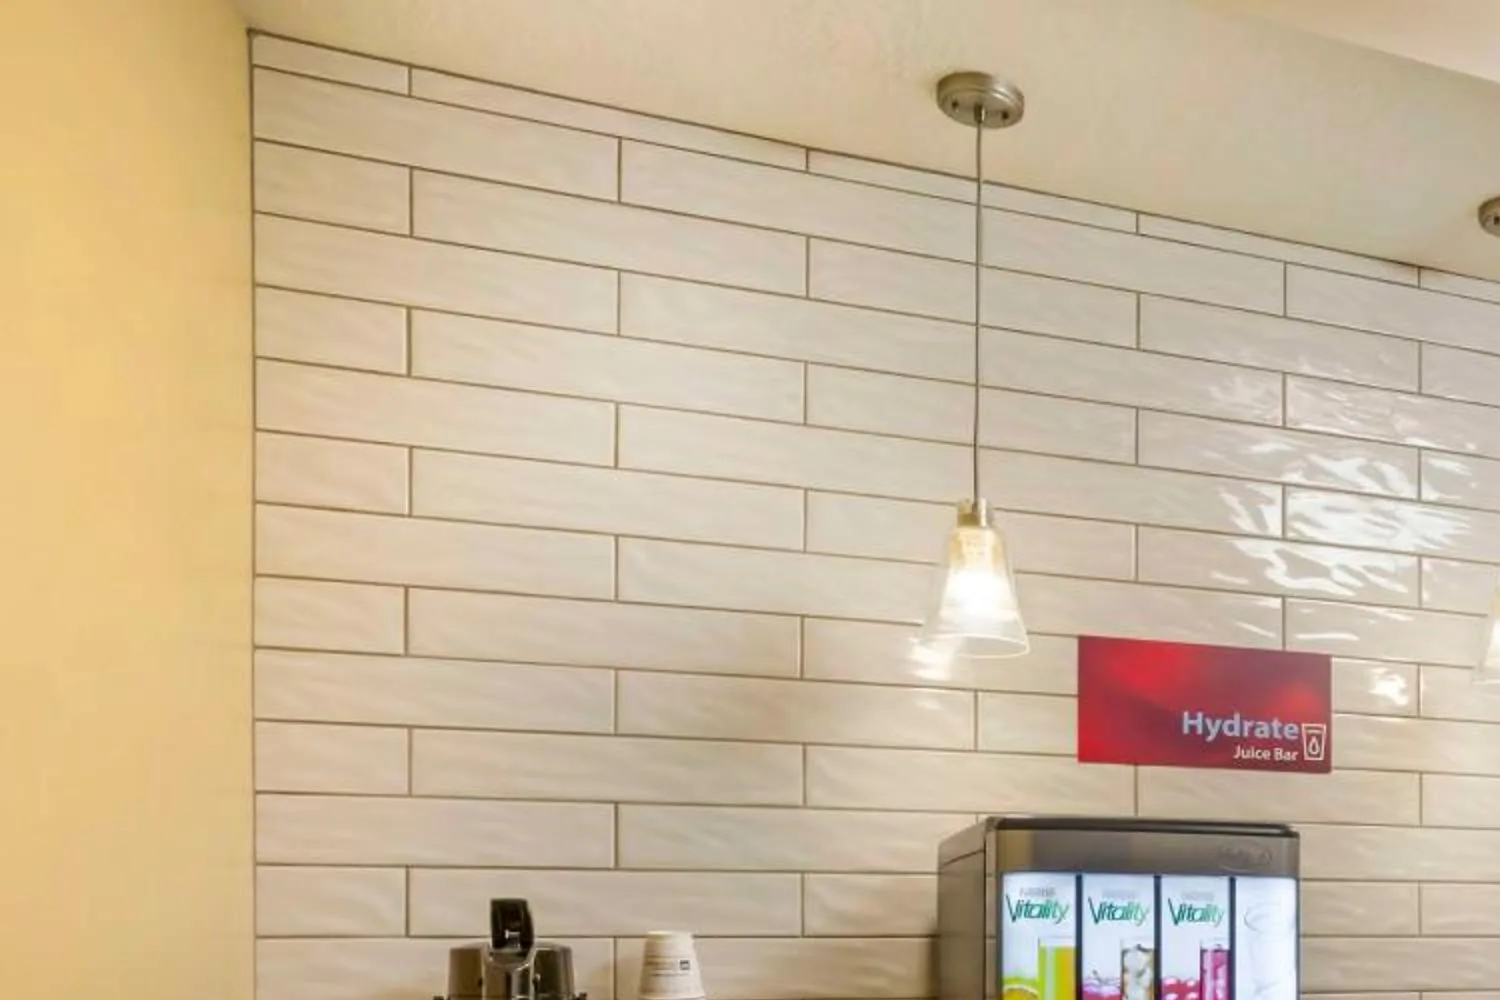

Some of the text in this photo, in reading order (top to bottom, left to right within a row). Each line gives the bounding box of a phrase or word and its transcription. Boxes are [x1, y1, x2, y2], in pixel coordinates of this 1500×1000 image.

[1182, 711, 1300, 742] Hydrate
[1233, 744, 1299, 761] Juice Bar
[1005, 893, 1070, 925] Vitality
[1087, 896, 1149, 927] Vitality
[1167, 897, 1225, 928] Vitality
